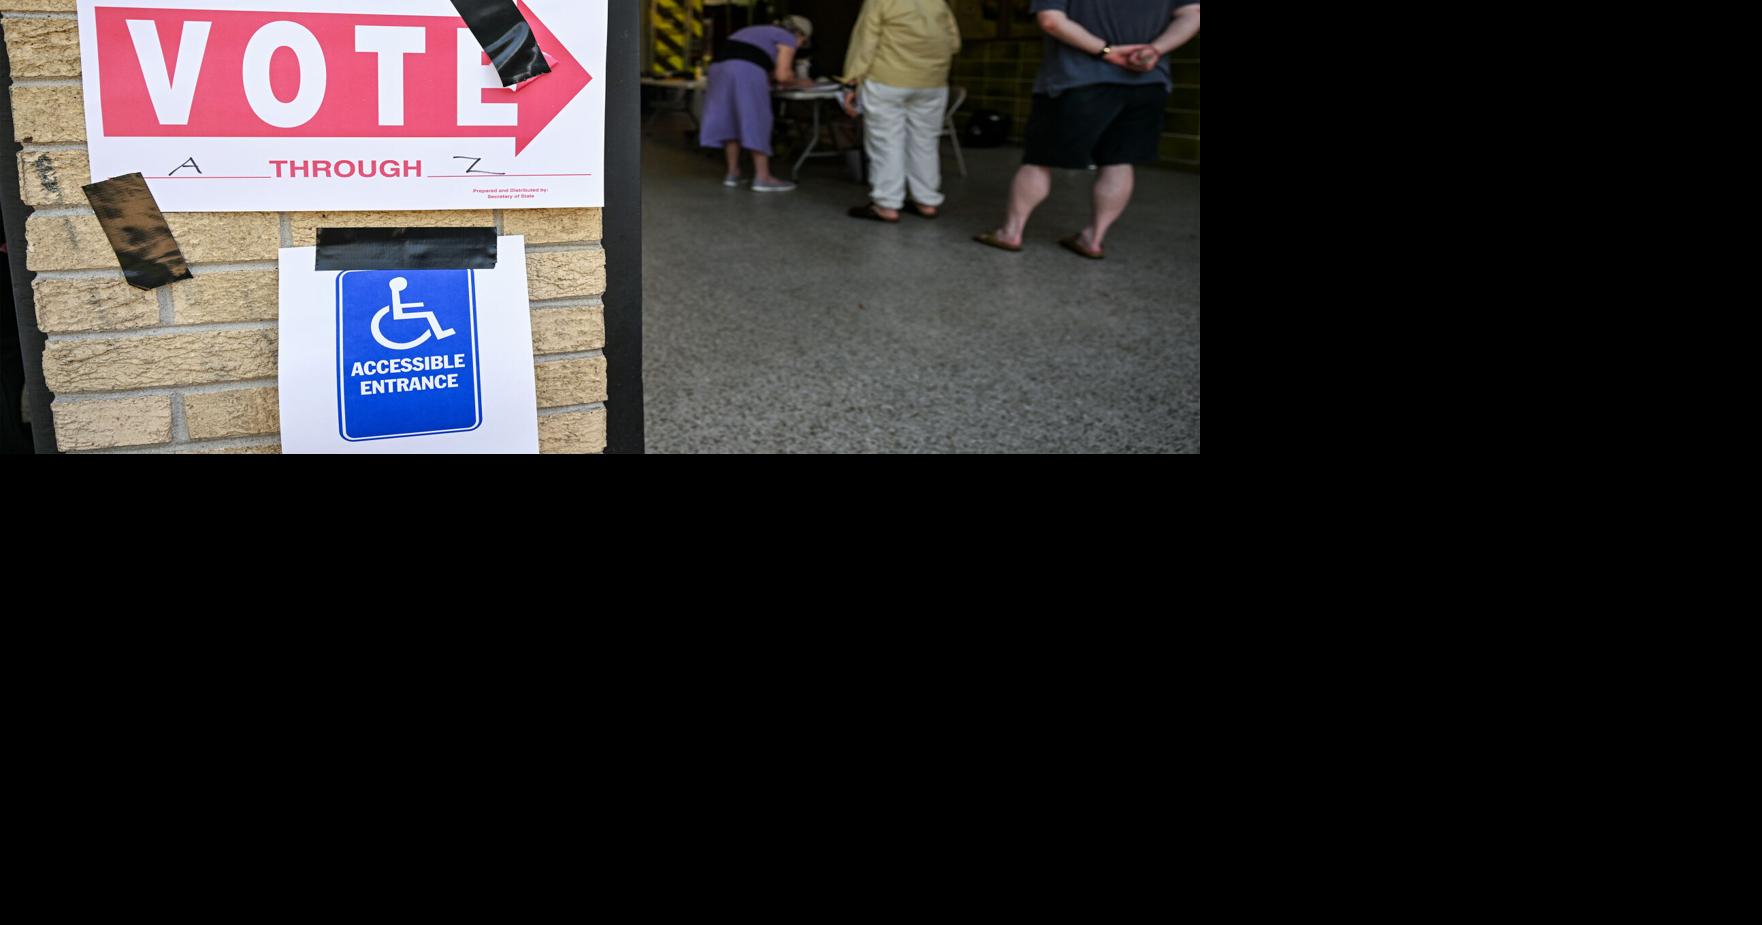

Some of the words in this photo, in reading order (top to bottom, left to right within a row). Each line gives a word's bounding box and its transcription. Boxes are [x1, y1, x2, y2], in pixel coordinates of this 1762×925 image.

[125, 19, 519, 128] VOTE
[168, 156, 203, 176] A
[269, 159, 422, 178] THROUGH
[452, 155, 506, 175] Z
[351, 353, 465, 376] ACCESSIBLE
[360, 374, 459, 395] ENTRANCE
